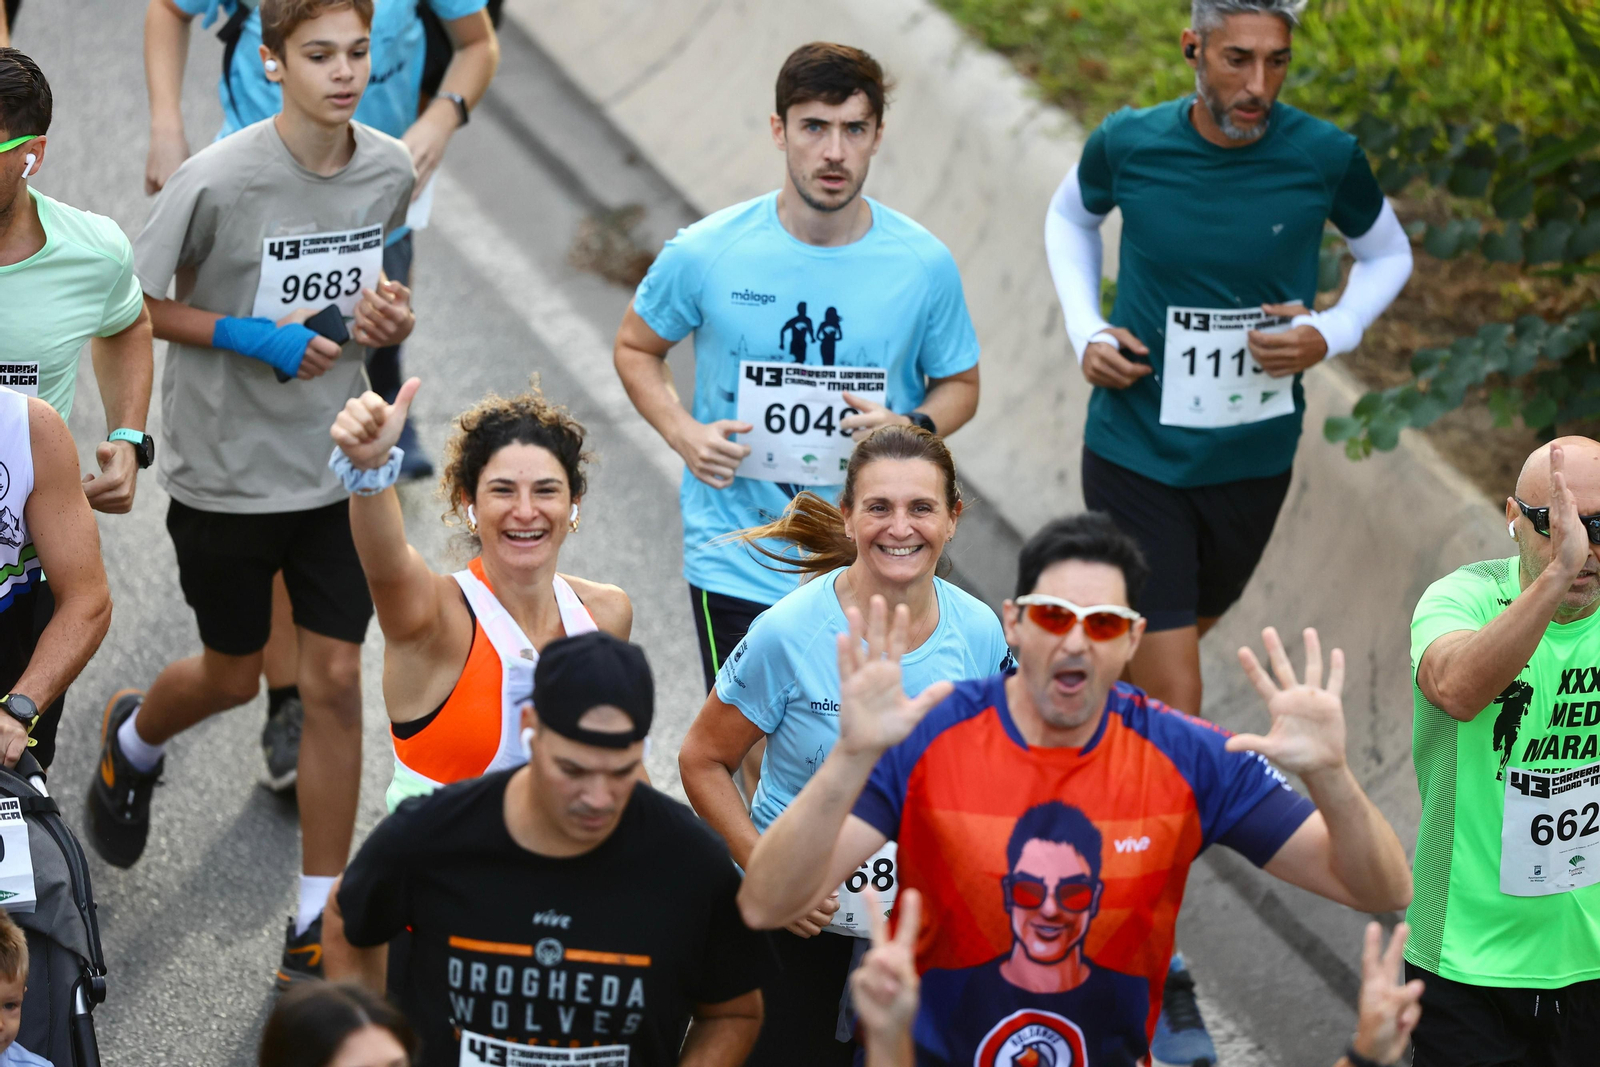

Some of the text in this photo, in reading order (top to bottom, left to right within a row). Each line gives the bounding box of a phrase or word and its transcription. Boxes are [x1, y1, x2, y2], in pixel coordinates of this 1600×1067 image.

[269, 240, 300, 260] 43
[281, 267, 361, 304] 9683
[1174, 312, 1209, 331] 43
[1182, 346, 1264, 377] 111
[746, 366, 783, 387] 43
[828, 382, 884, 391] MALAGA
[1510, 765, 1600, 799] 43 CARRERA
[1552, 780, 1582, 795] CIUDAD
[449, 957, 645, 1008] DROGHEDA
[450, 991, 642, 1035] WOLVES
[469, 1038, 508, 1066] 43
